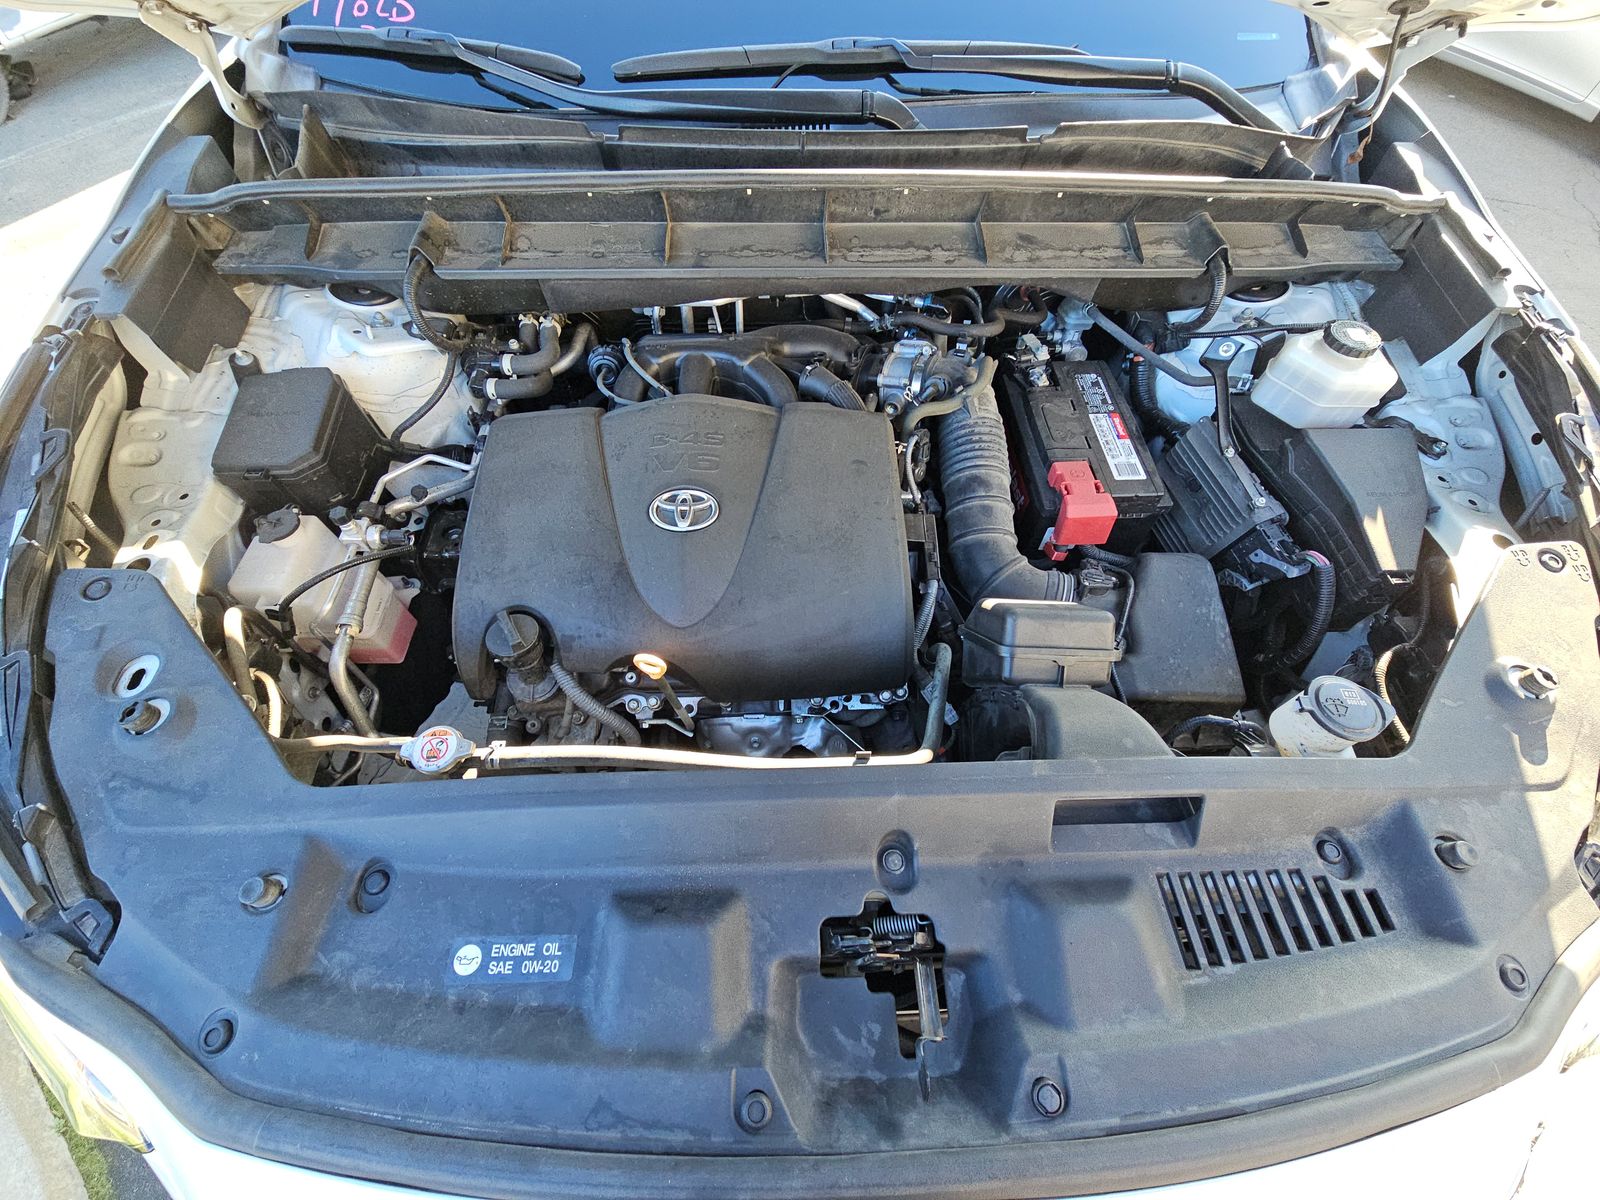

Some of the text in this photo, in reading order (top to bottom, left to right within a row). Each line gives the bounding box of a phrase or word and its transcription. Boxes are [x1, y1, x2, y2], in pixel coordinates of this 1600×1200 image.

[652, 451, 721, 473] V6
[491, 942, 562, 957] ENGINE OIL
[488, 960, 559, 975] SAE 0W-20
